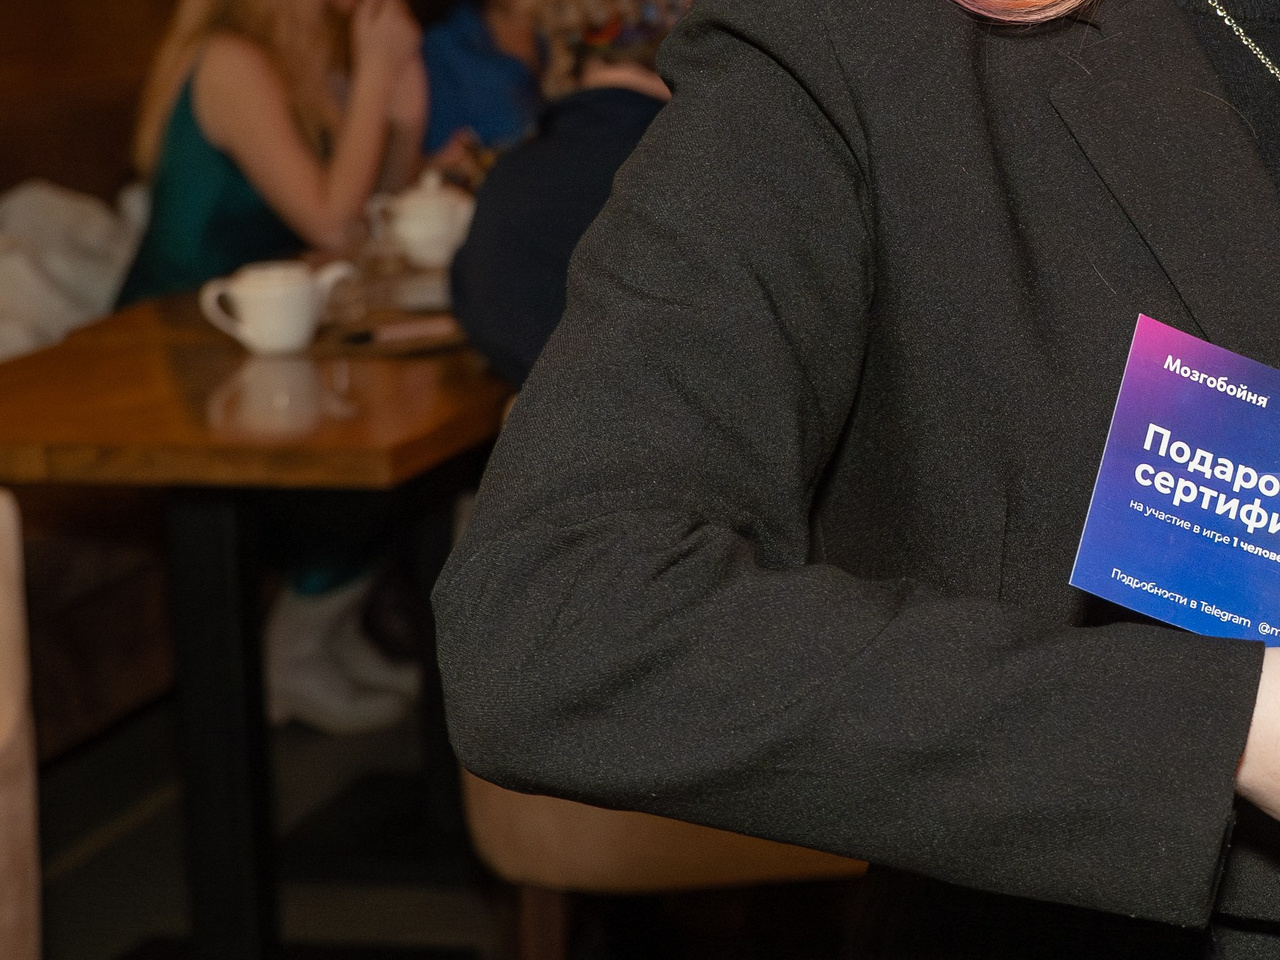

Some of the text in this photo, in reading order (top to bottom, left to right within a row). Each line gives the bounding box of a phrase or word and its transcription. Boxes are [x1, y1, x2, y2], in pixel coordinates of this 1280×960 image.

[1163, 355, 1268, 408] Мозгобойня
[1129, 499, 1144, 512] на
[1144, 505, 1191, 530] участие
[1192, 524, 1200, 533] в
[1202, 527, 1231, 545] игре
[1232, 537, 1239, 547] 1
[1110, 567, 1188, 606] Подробности
[1189, 599, 1198, 609] в
[1200, 600, 1251, 628] Telegram
